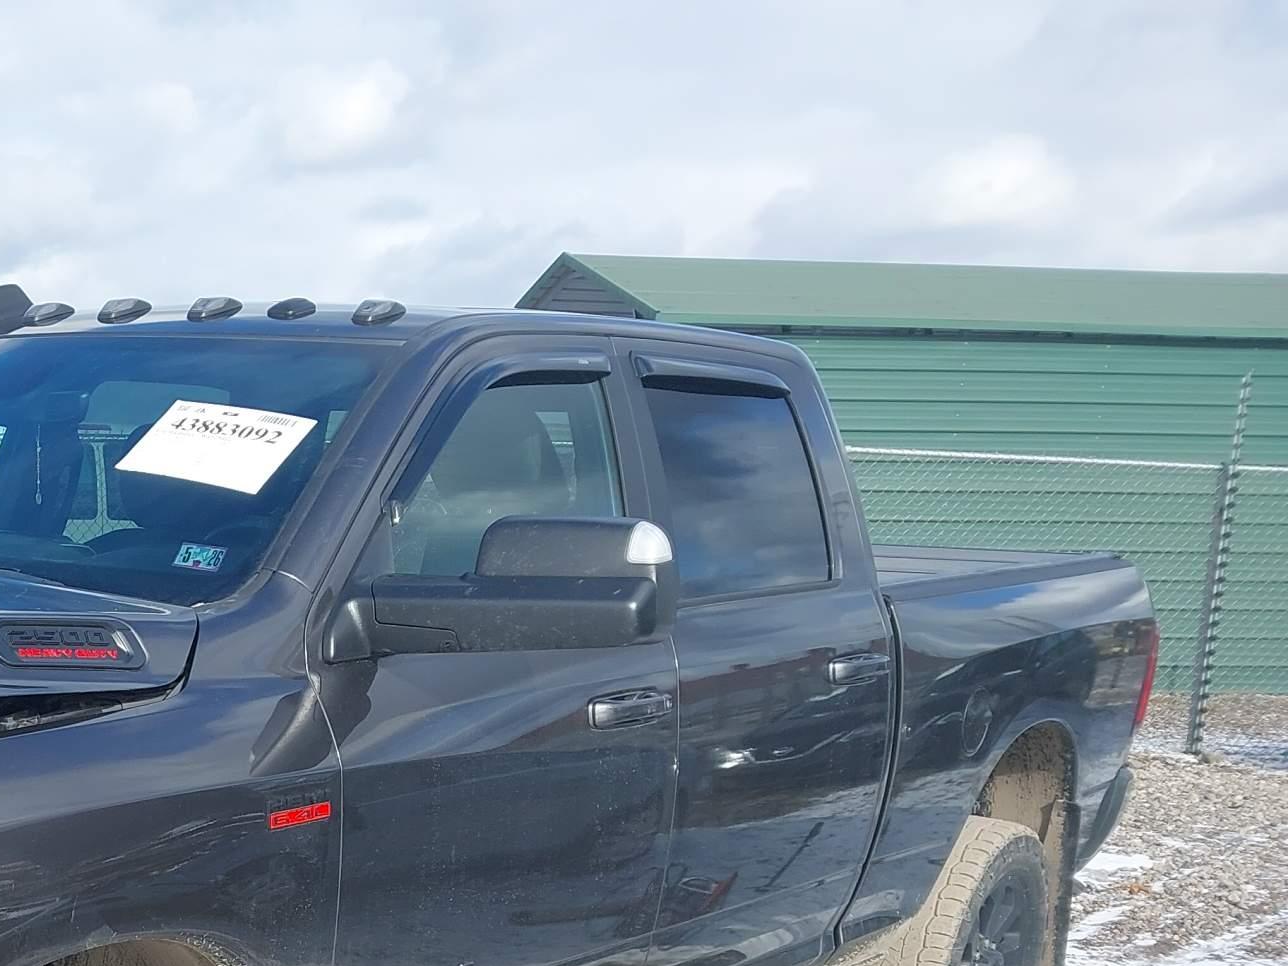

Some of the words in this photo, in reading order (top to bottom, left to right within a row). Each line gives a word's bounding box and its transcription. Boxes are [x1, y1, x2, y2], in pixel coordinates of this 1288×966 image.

[171, 416, 283, 445] 43883092
[182, 546, 193, 564] 5
[207, 550, 224, 567] 26
[7, 629, 112, 647] 2500
